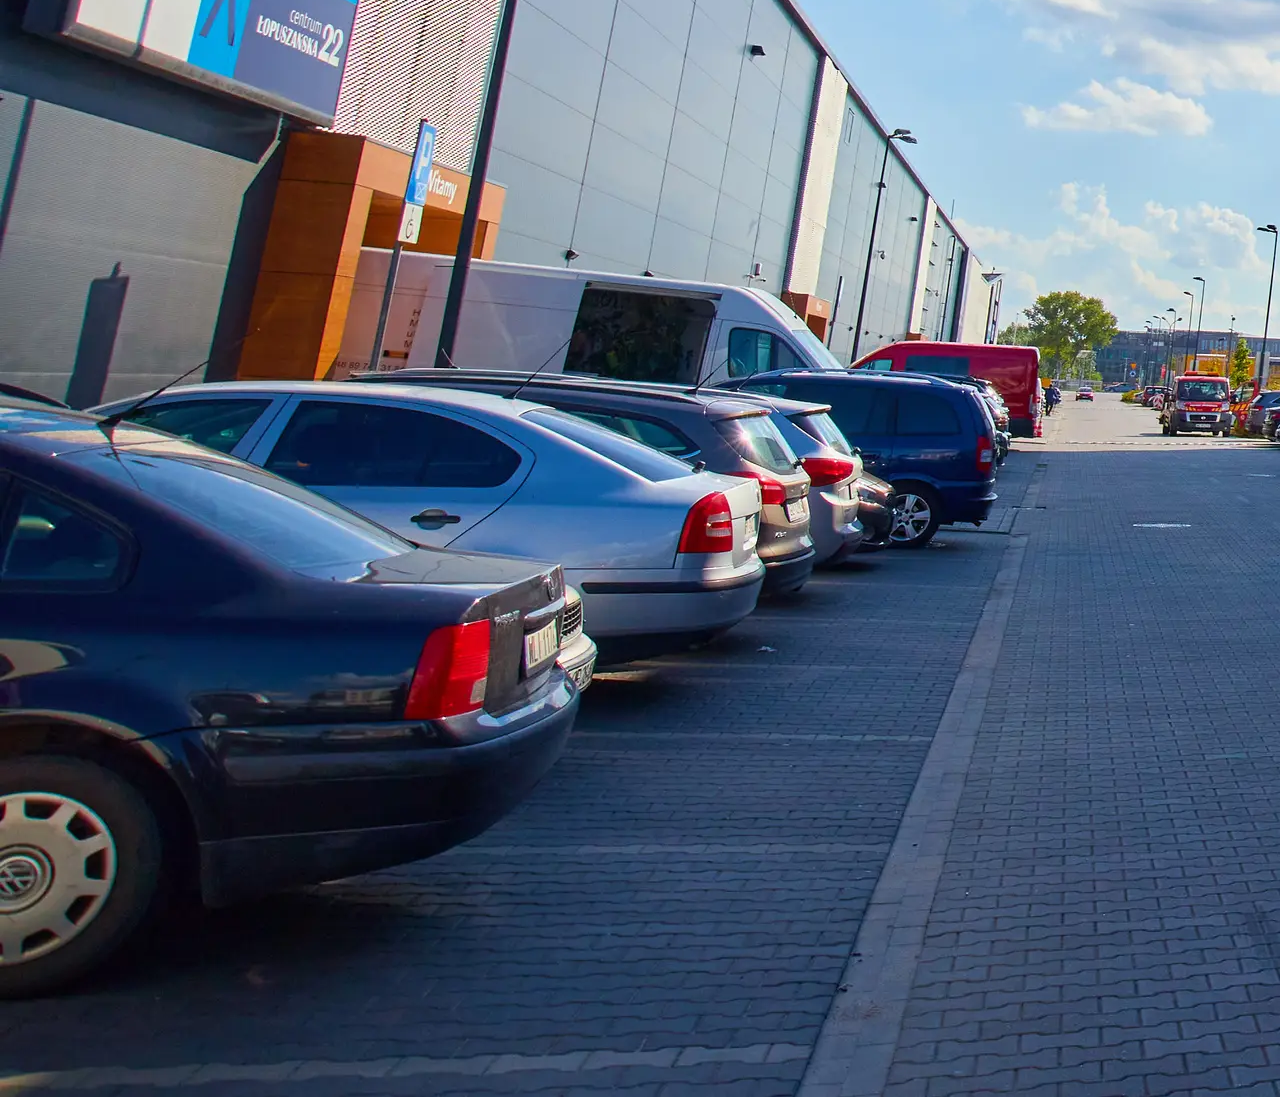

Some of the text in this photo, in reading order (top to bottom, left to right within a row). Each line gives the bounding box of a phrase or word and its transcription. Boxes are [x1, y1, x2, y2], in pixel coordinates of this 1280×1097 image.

[290, 9, 322, 34] centrum
[318, 23, 344, 67] 22
[416, 131, 432, 180] P
